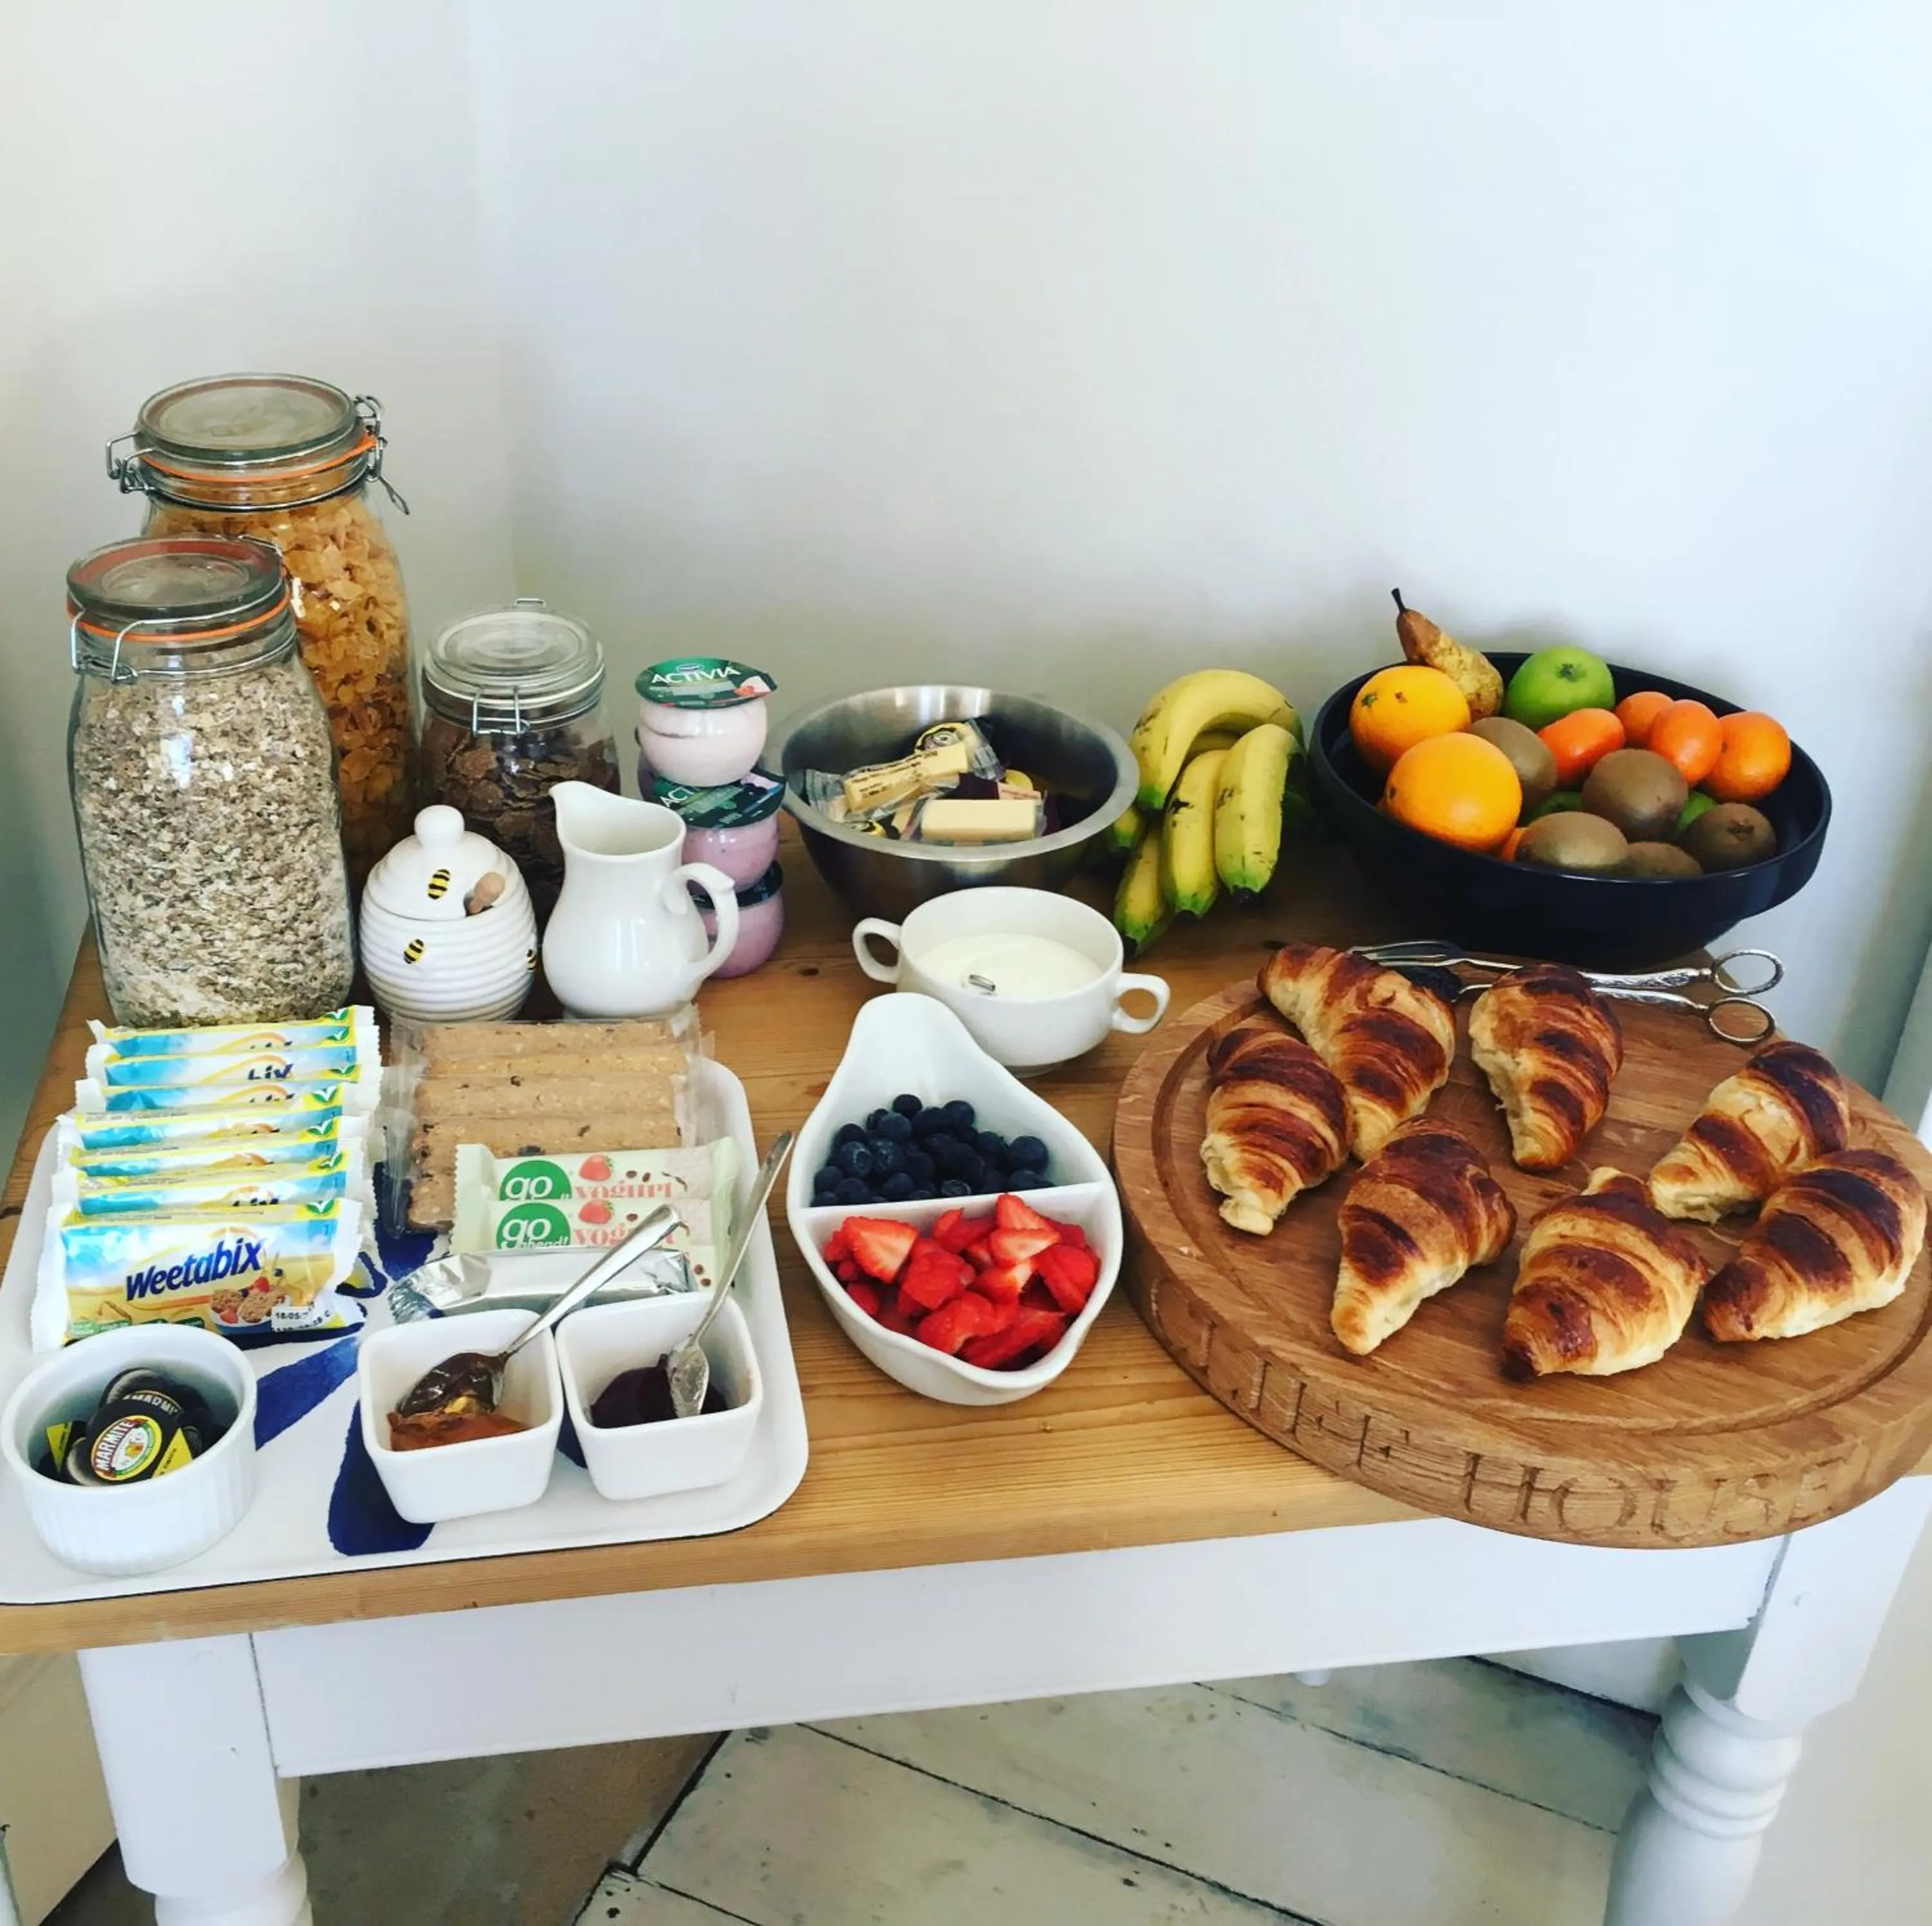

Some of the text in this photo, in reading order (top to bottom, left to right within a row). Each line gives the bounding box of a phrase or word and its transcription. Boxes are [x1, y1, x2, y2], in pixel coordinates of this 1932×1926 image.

[651, 666, 741, 683] ACTIVIA
[504, 1176, 553, 1200] go
[500, 1218, 552, 1248] go
[126, 1237, 266, 1301] Weetabix
[95, 1420, 135, 1471] MARMITE
[1458, 1449, 1848, 1541] HOUSE
